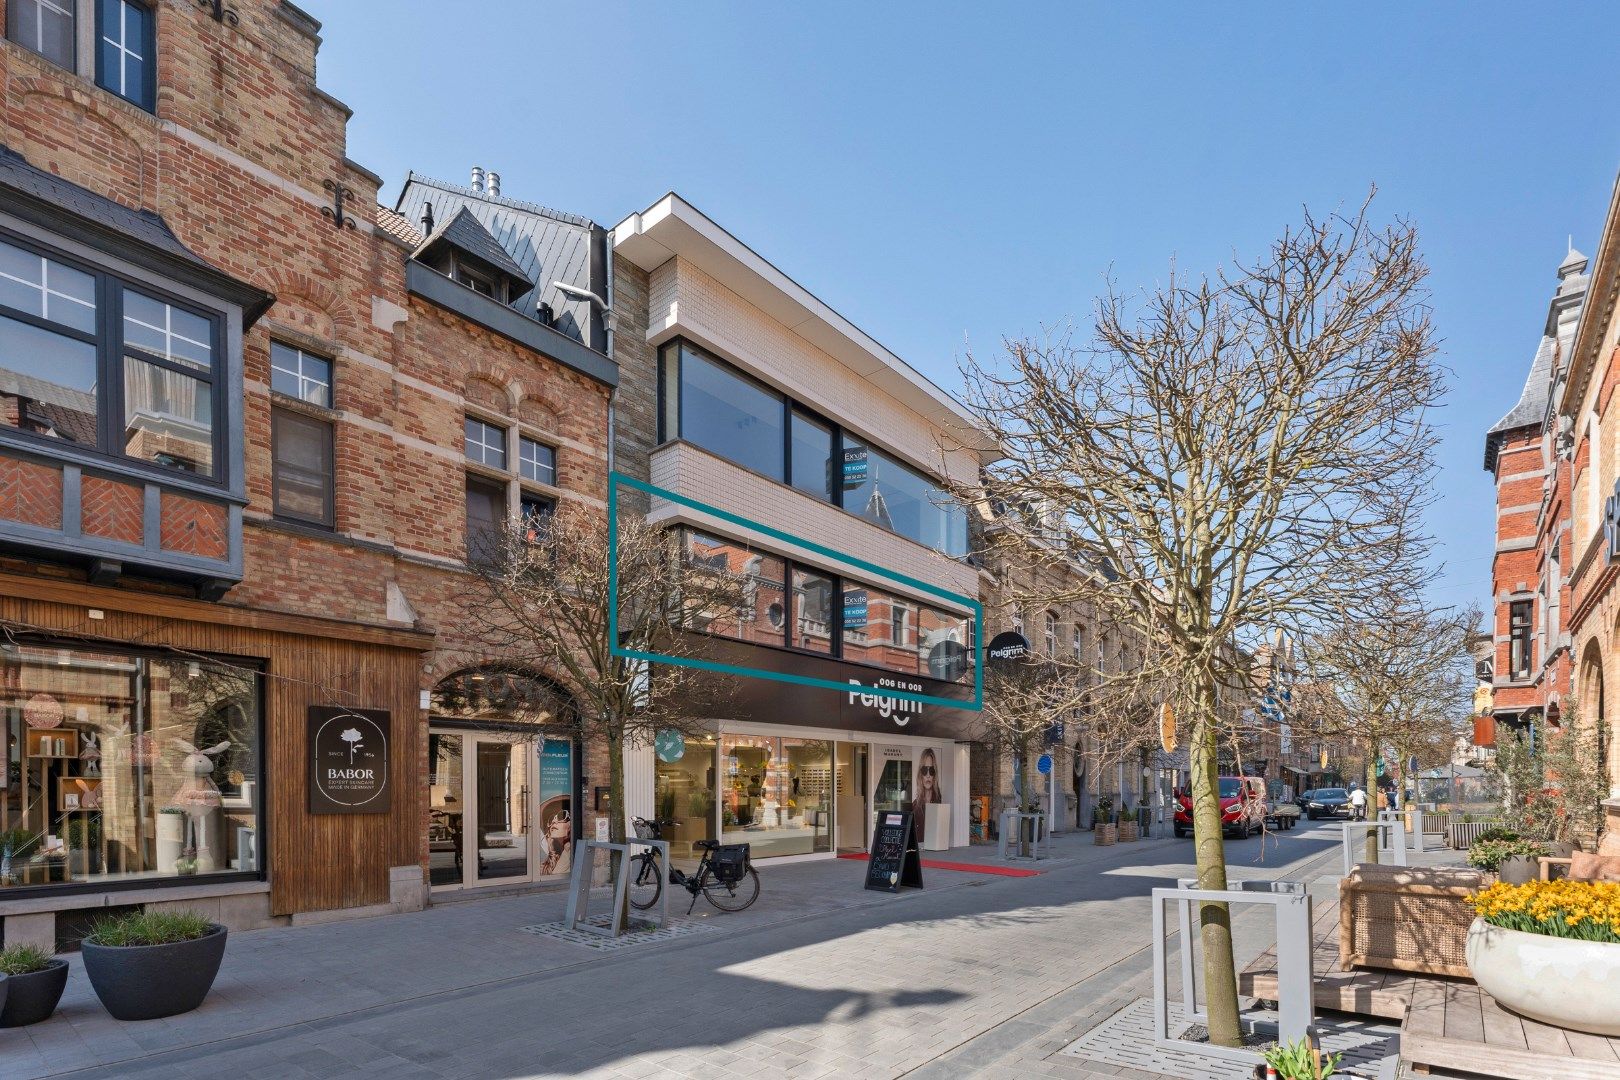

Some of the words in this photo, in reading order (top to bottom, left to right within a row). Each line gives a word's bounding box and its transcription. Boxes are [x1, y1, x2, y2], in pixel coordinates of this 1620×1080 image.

[990, 648, 1023, 658] Pelgrim
[898, 681, 906, 689] EN
[328, 768, 375, 779] BABOR
